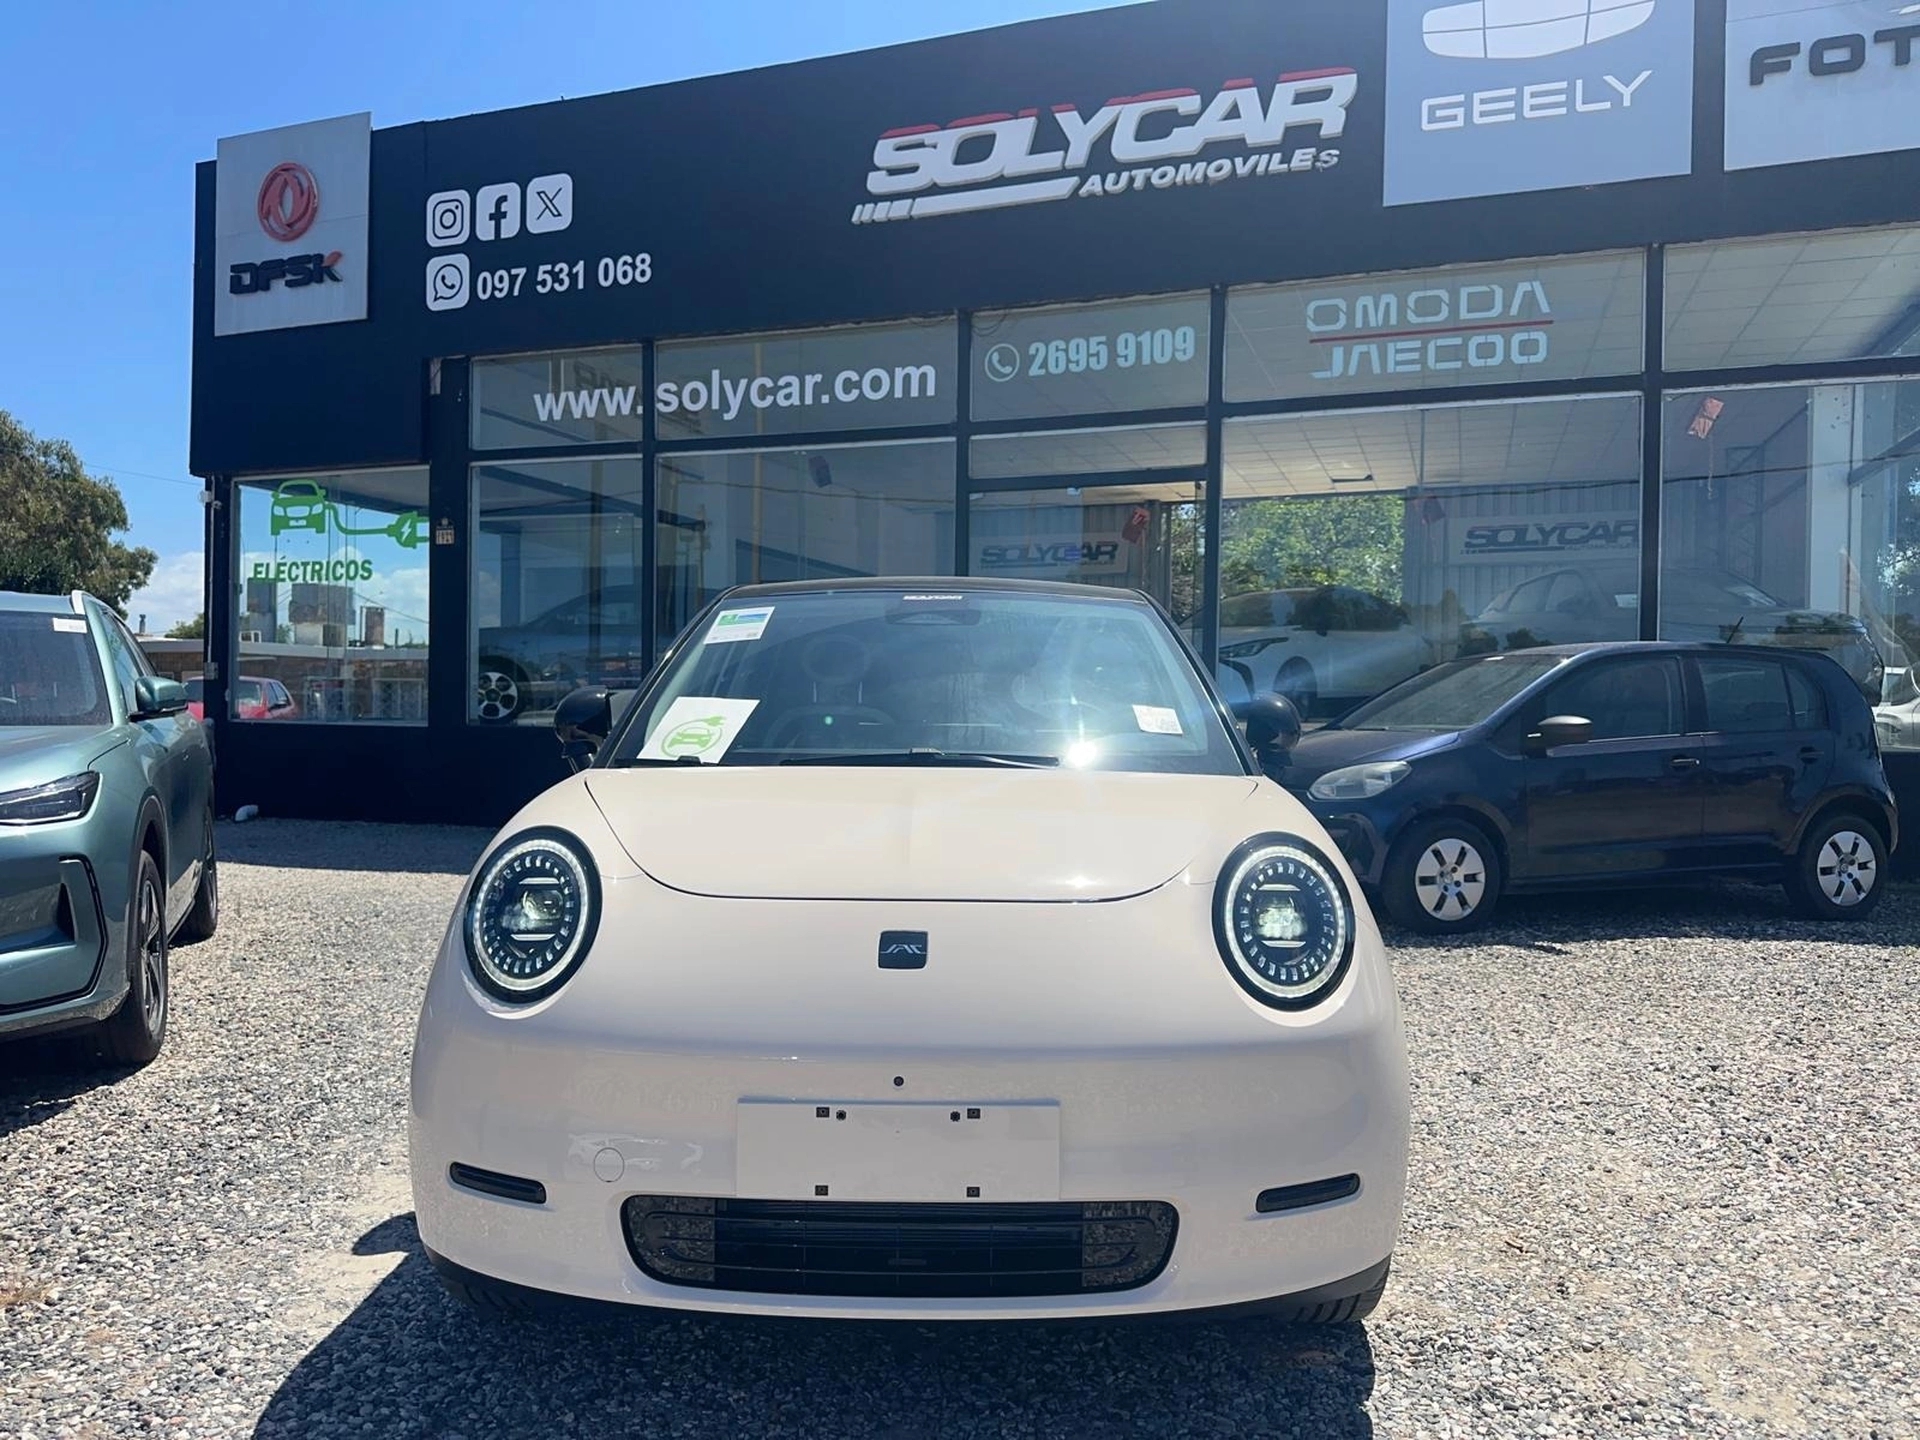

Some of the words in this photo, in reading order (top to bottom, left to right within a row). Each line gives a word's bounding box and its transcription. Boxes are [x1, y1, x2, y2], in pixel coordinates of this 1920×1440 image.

[1421, 70, 1652, 131] GEELY
[865, 67, 1358, 195] SOLYCAR
[1078, 147, 1341, 198] AUTOMOVILES
[229, 251, 343, 294] DFSK
[476, 267, 527, 300] 097
[536, 260, 585, 294] 531
[597, 253, 652, 287] 068
[1306, 280, 1551, 332] OMODA
[1028, 336, 1107, 376] 2695
[1117, 326, 1195, 367] 9109
[1308, 331, 1548, 379] JAECOO
[252, 555, 373, 582] ELÉCTRICOS
